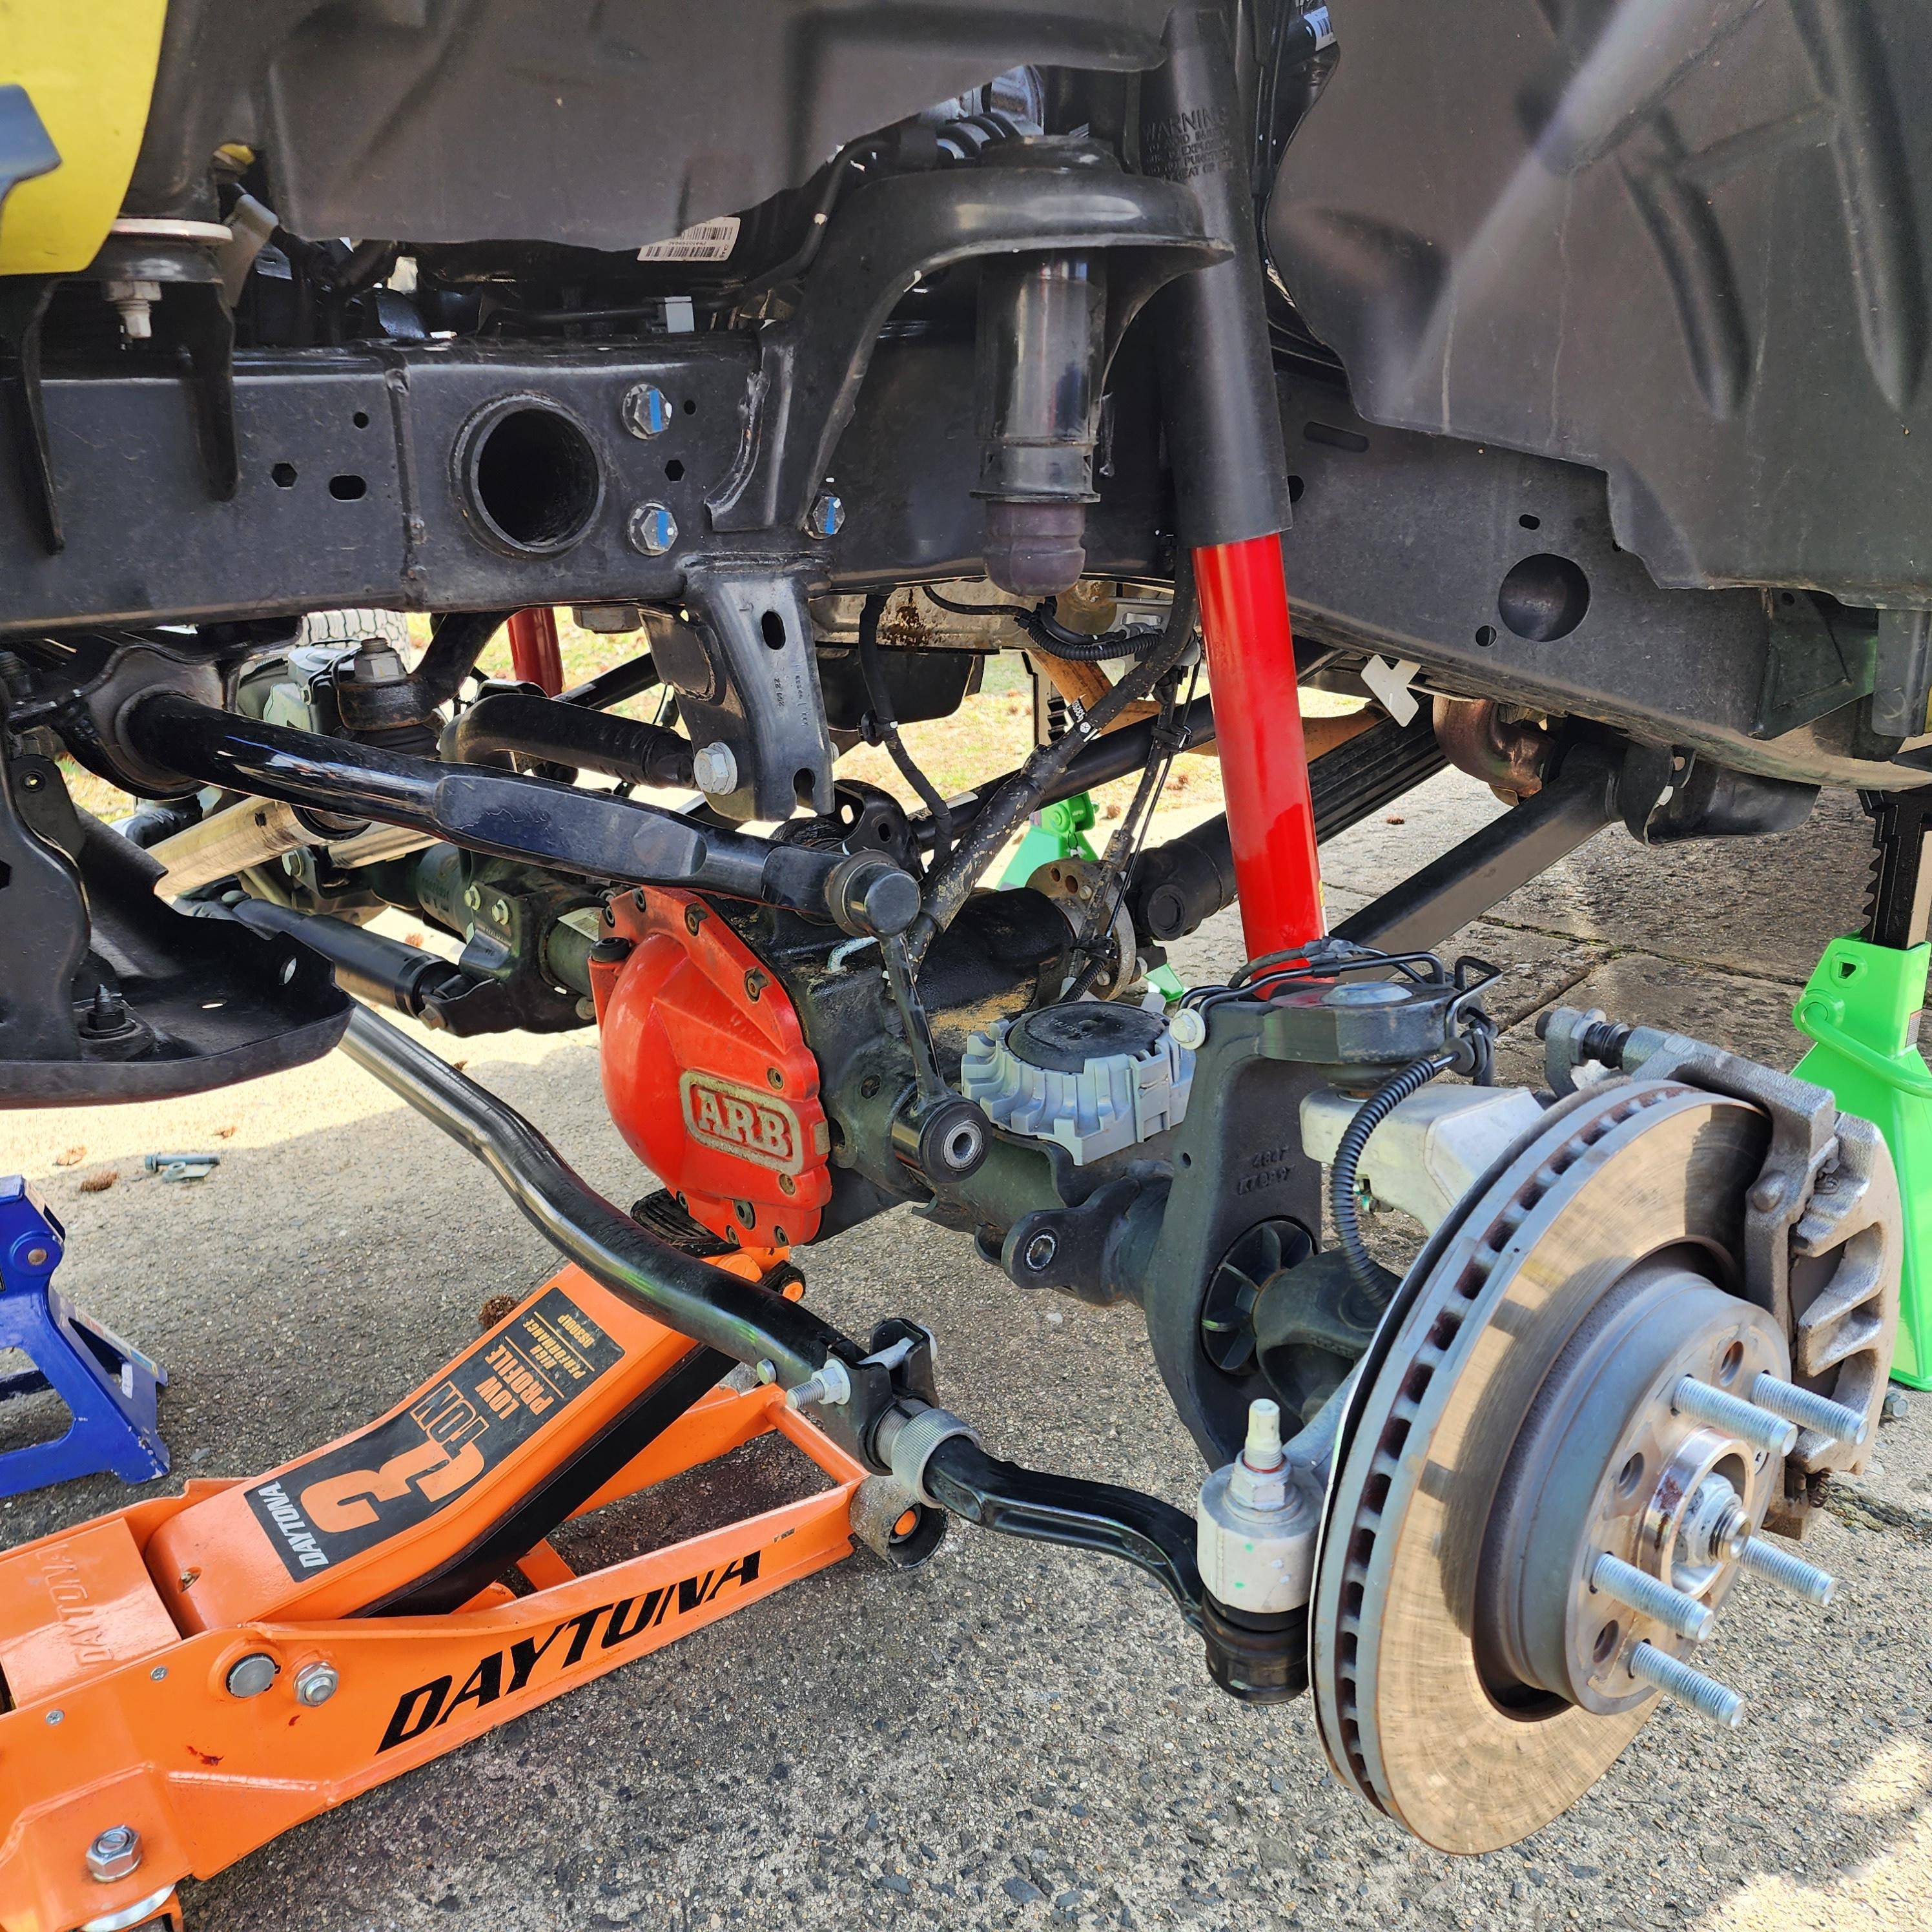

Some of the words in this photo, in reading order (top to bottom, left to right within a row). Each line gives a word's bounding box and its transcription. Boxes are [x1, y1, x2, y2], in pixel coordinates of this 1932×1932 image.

[697, 1089, 788, 1156] ARB
[522, 1319, 586, 1379] PERFORMANCE
[529, 1344, 557, 1370] HIGH
[557, 1313, 595, 1349] DS300LP
[475, 1376, 520, 1420] LOW
[484, 1344, 554, 1415] PROFILE
[409, 1380, 490, 1462] TON
[300, 1440, 485, 1533] 3
[258, 1481, 330, 1568] DAYTONA
[375, 1550, 761, 1756] DAYTONA
